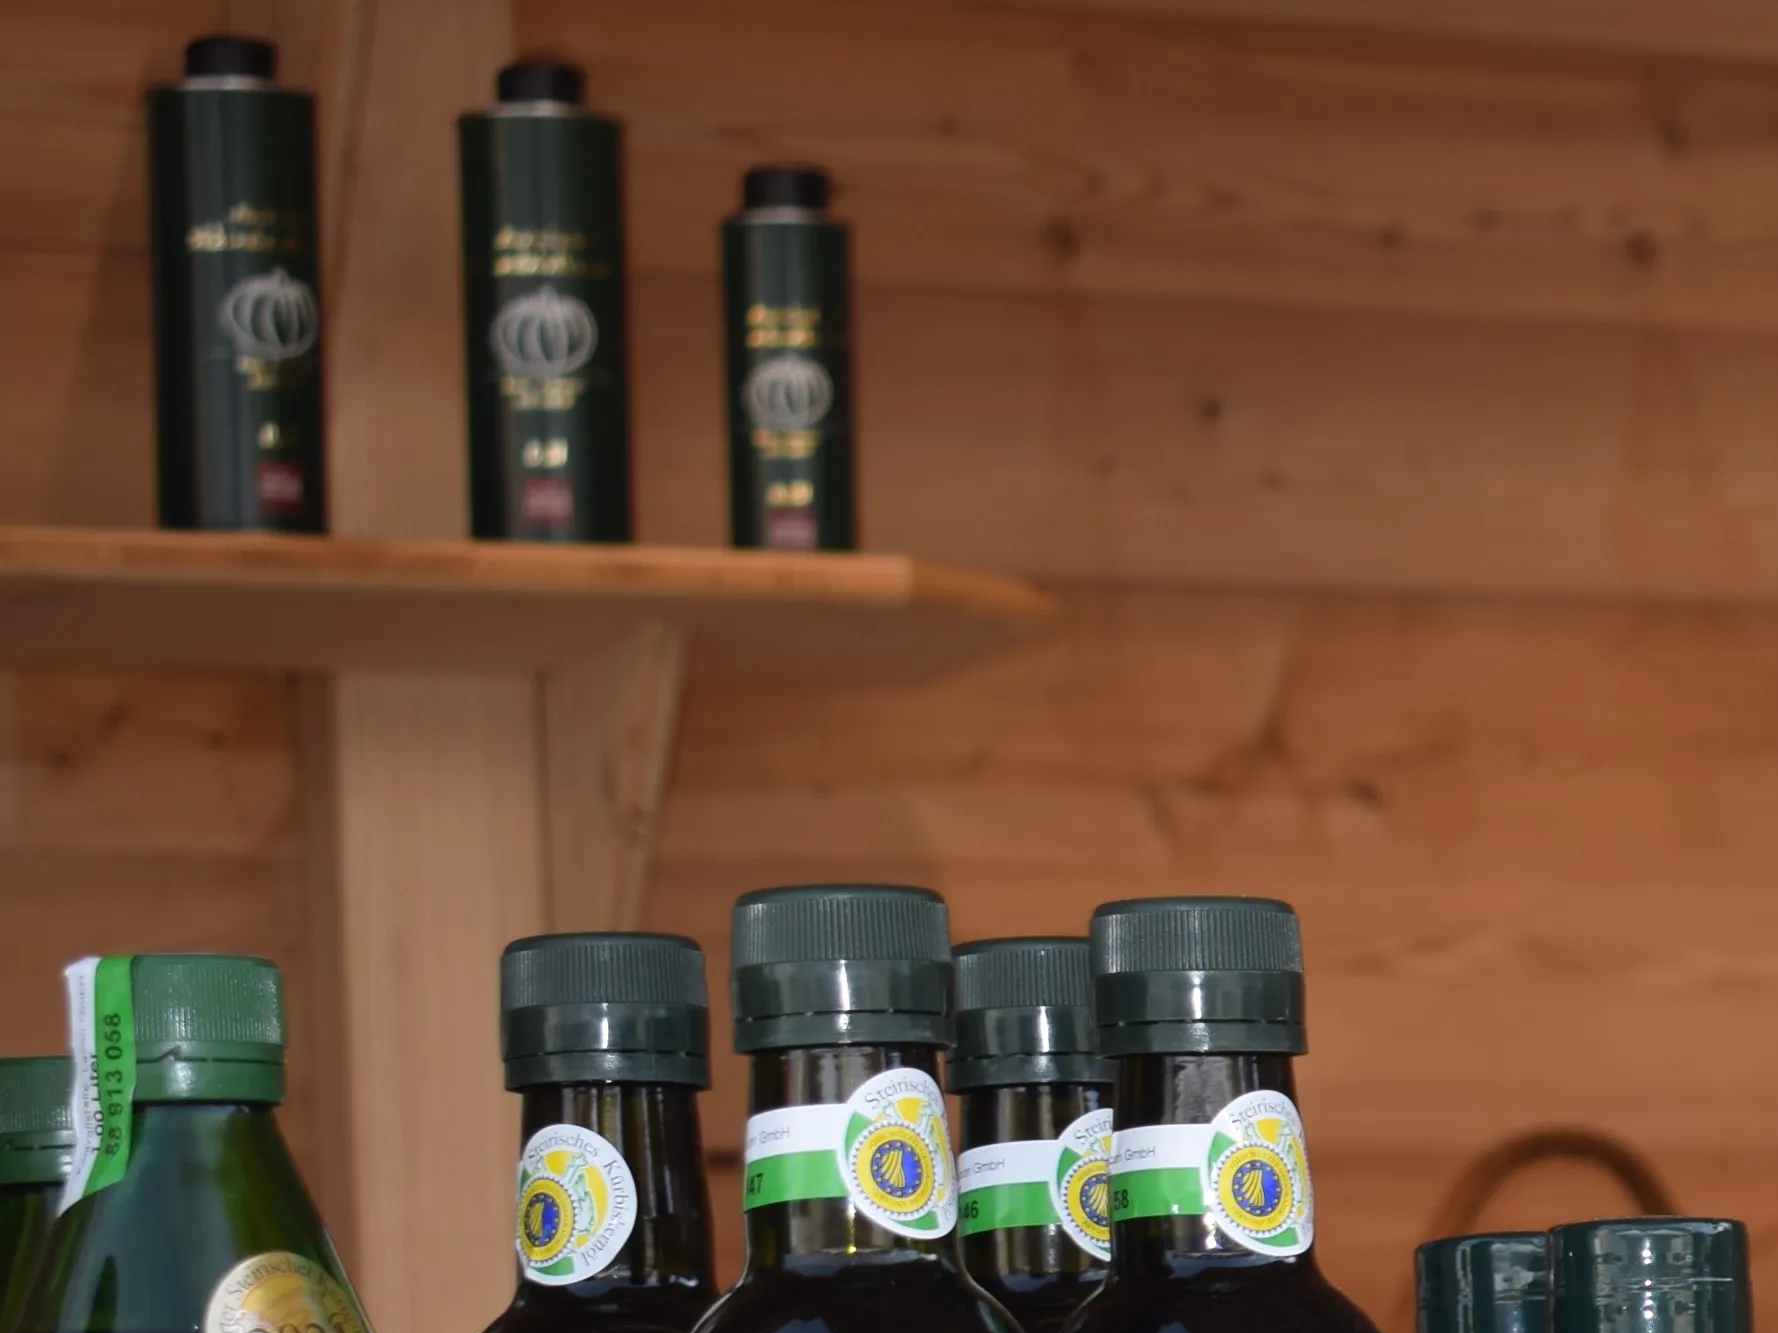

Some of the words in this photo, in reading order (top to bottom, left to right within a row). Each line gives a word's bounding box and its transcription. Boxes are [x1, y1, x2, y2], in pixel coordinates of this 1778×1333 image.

[104, 1012, 123, 1060] 058
[107, 1069, 124, 1117] 913
[759, 1126, 791, 1144] GmbH
[1124, 1146, 1156, 1162] GmbH
[973, 1158, 1006, 1174] GmbH
